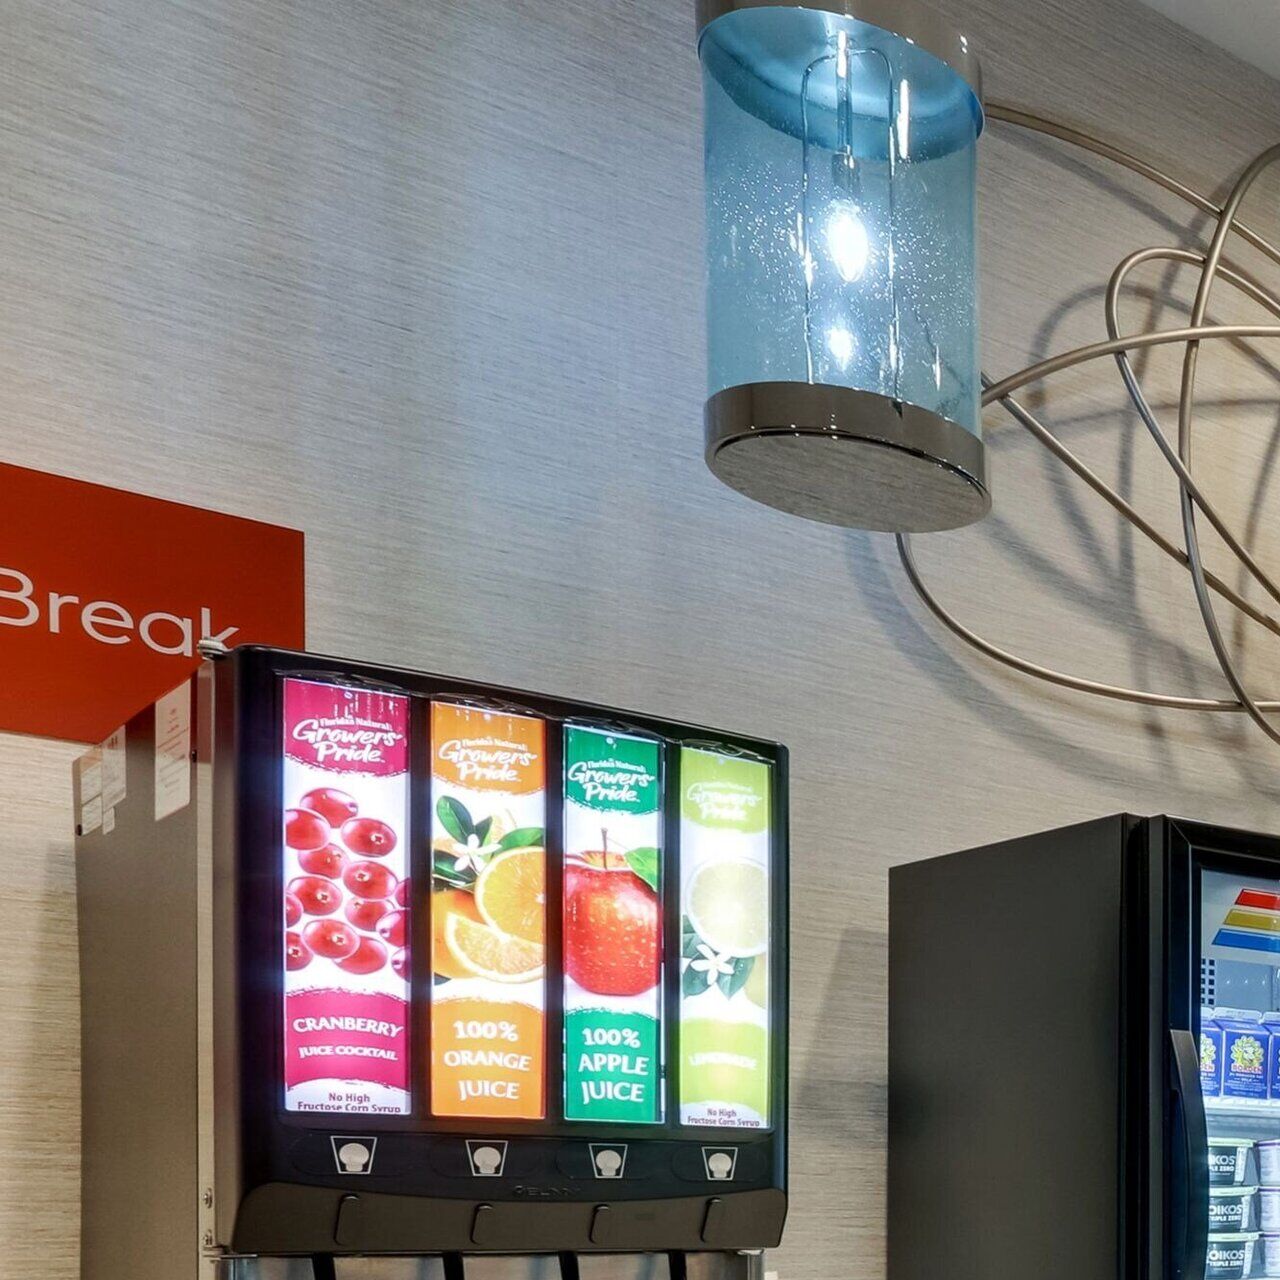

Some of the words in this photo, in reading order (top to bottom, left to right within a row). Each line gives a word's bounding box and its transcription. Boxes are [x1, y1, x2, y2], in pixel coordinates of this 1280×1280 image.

[0, 566, 240, 657] Break
[293, 719, 404, 747] Growers
[312, 741, 386, 763] Pride
[439, 740, 537, 766] Growers
[456, 761, 522, 780] Pride
[567, 762, 656, 787] Growers
[582, 782, 640, 803] Pride
[293, 1016, 404, 1038] CRANBERRY
[453, 1020, 519, 1042] 100%
[582, 1027, 641, 1049] 100%
[298, 1045, 334, 1059] JUICE
[335, 1045, 398, 1061] COCKTAIL
[443, 1050, 532, 1072] ORANGE
[578, 1053, 649, 1076] APPLE
[328, 1092, 343, 1102] No
[346, 1092, 371, 1103] High
[458, 1079, 520, 1101] JUICE
[581, 1080, 645, 1105] JUICE
[297, 1101, 342, 1112] Fructose
[345, 1103, 369, 1112] Corn
[707, 1108, 718, 1116] No
[719, 1108, 737, 1118] High
[1209, 1249, 1245, 1261] OIKOS
